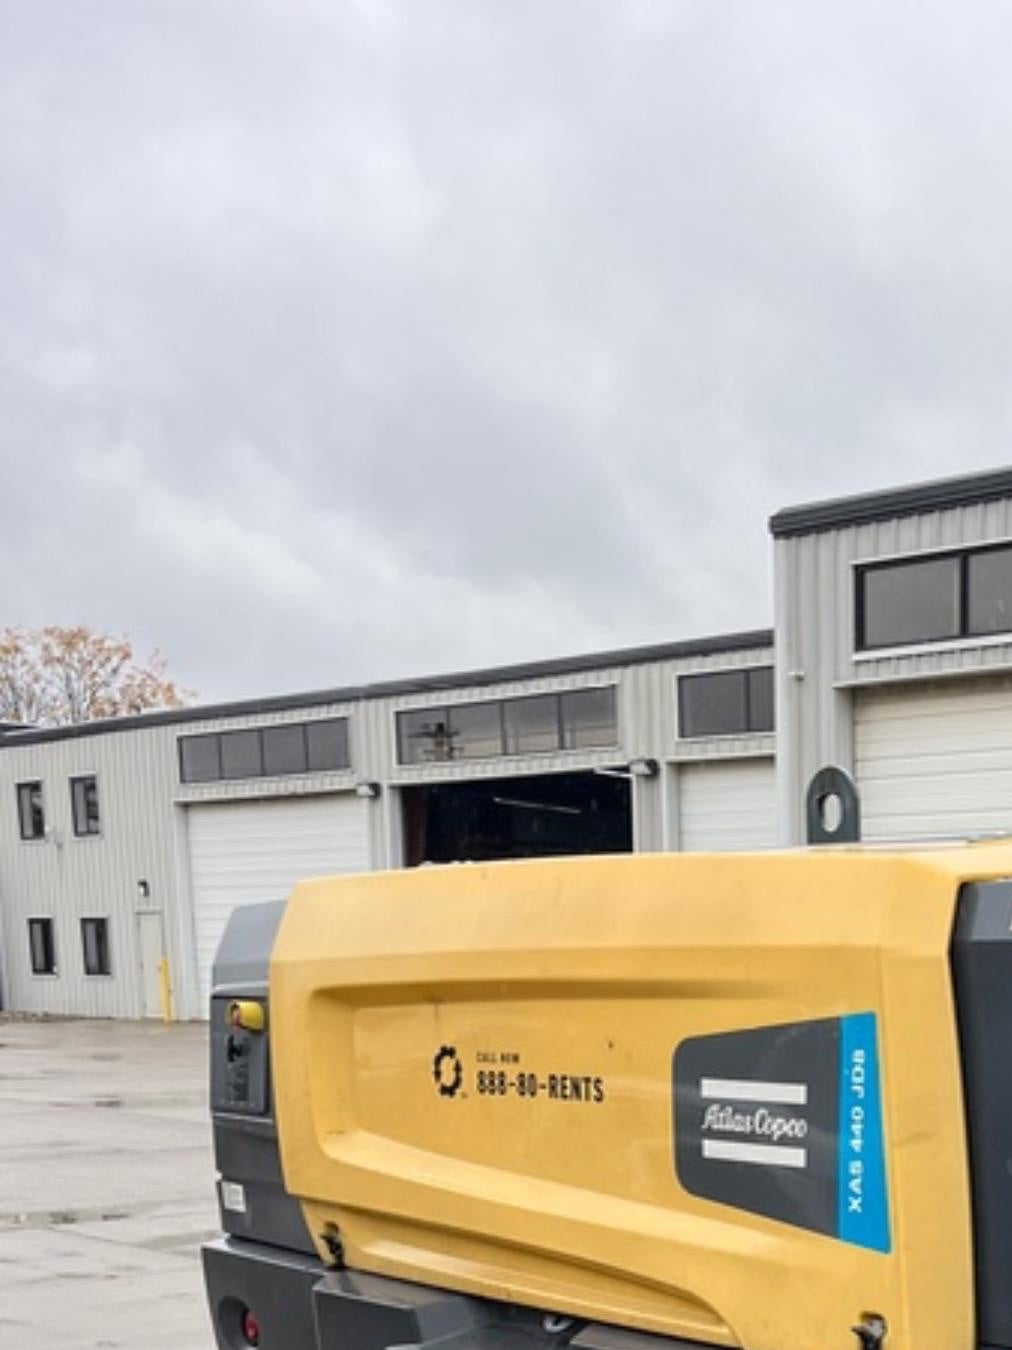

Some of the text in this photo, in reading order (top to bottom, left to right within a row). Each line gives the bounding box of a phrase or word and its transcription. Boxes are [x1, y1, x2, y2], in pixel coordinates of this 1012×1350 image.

[477, 1070, 604, 1103] 888-80-RENTS
[701, 1103, 808, 1141] Atlas Copco
[850, 1106, 865, 1152] 440
[848, 1160, 864, 1213] XAS
